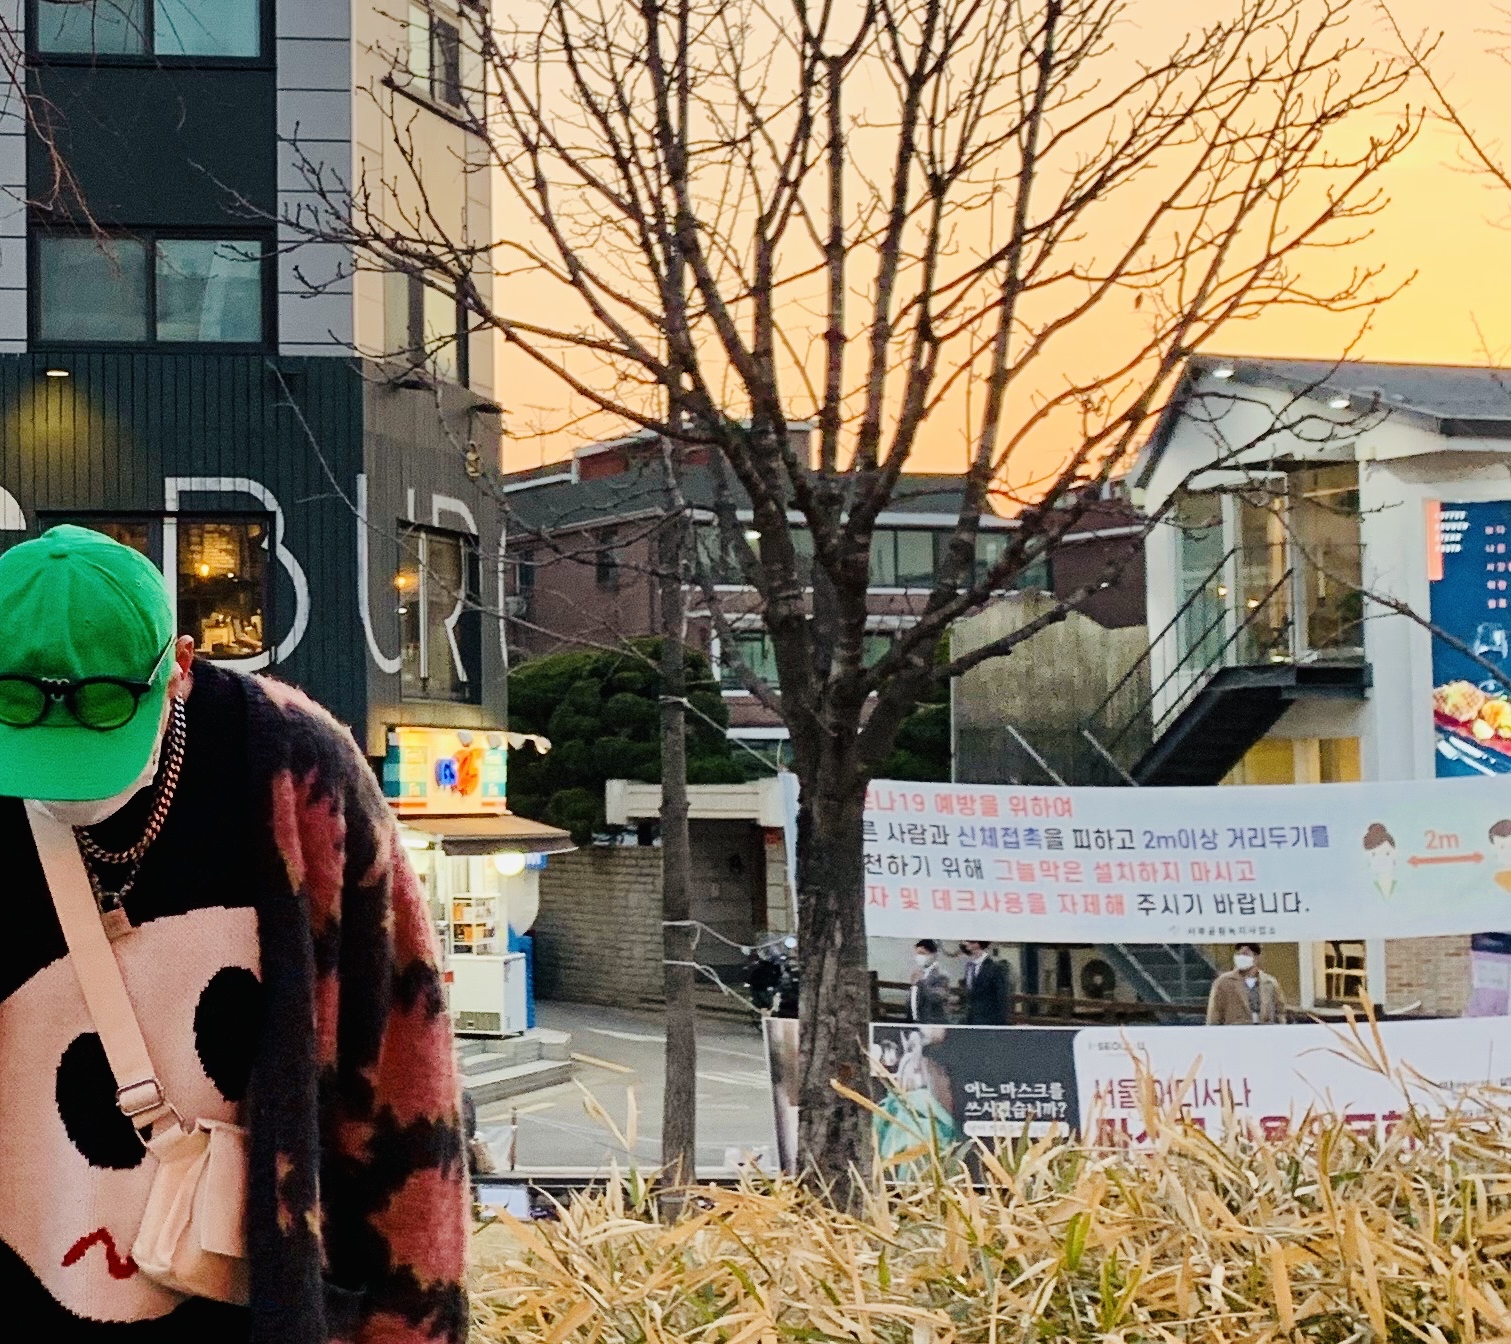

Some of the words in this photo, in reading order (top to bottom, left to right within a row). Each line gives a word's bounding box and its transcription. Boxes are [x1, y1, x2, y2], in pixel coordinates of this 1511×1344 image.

[934, 793, 1000, 818] 예방을
[1009, 795, 1074, 819] 위하여
[888, 821, 950, 846] 사람과
[957, 825, 1064, 850] 신체접촉을
[1072, 827, 1136, 851] 피하고
[1142, 827, 1219, 851] 2m이상
[1226, 825, 1330, 850] 거리두기를
[1424, 829, 1460, 850] 2m
[942, 856, 985, 881] 위해
[993, 859, 1084, 884] 그늘막은
[1094, 860, 1181, 884] 설치하지
[1191, 859, 1257, 884] 마시고
[899, 886, 921, 911] 및
[932, 888, 1048, 916] 데크사용을
[1058, 892, 1127, 917] 자제해
[1136, 893, 1203, 917] 주시기
[1213, 891, 1311, 916] 바랍니다.
[964, 1081, 998, 1099] 어느
[1000, 1081, 1065, 1100] 마스크를
